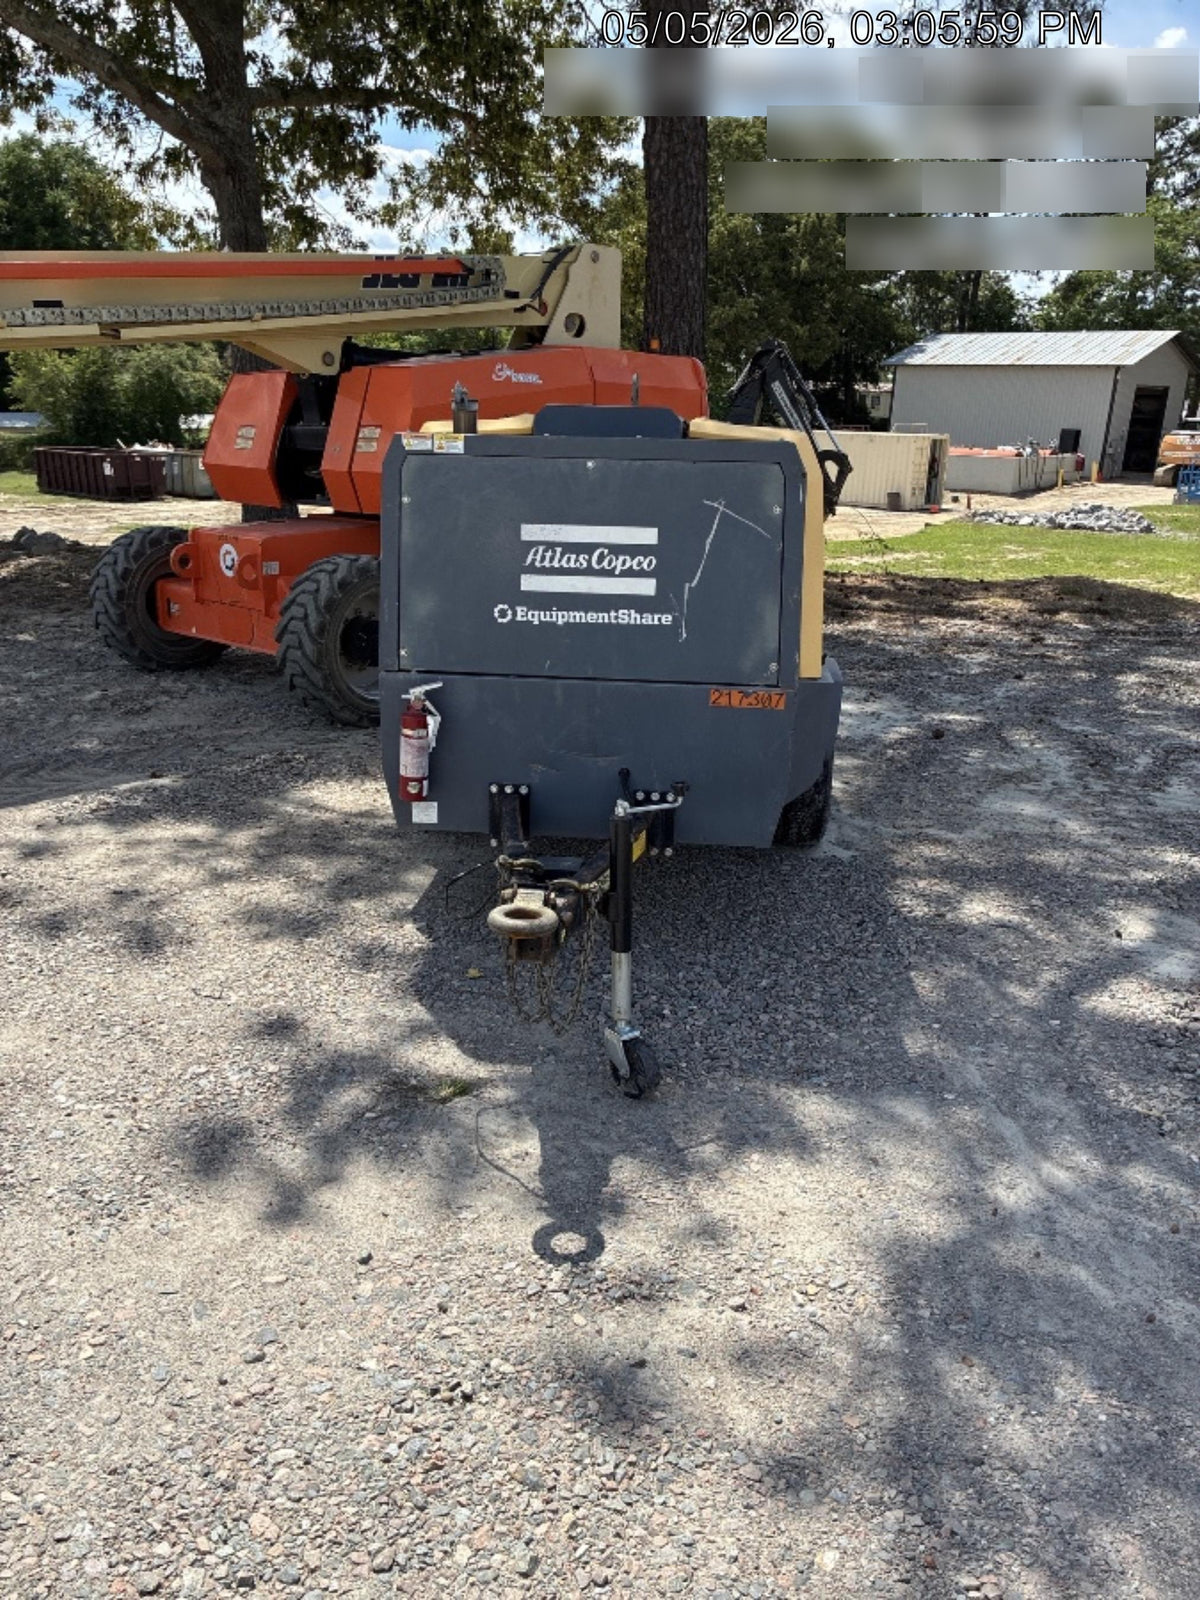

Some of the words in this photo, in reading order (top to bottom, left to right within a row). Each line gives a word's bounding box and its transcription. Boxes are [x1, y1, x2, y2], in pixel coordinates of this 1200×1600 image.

[523, 545, 590, 569] Atlas
[591, 547, 657, 575] Copco
[515, 605, 673, 626] EquipmentShare
